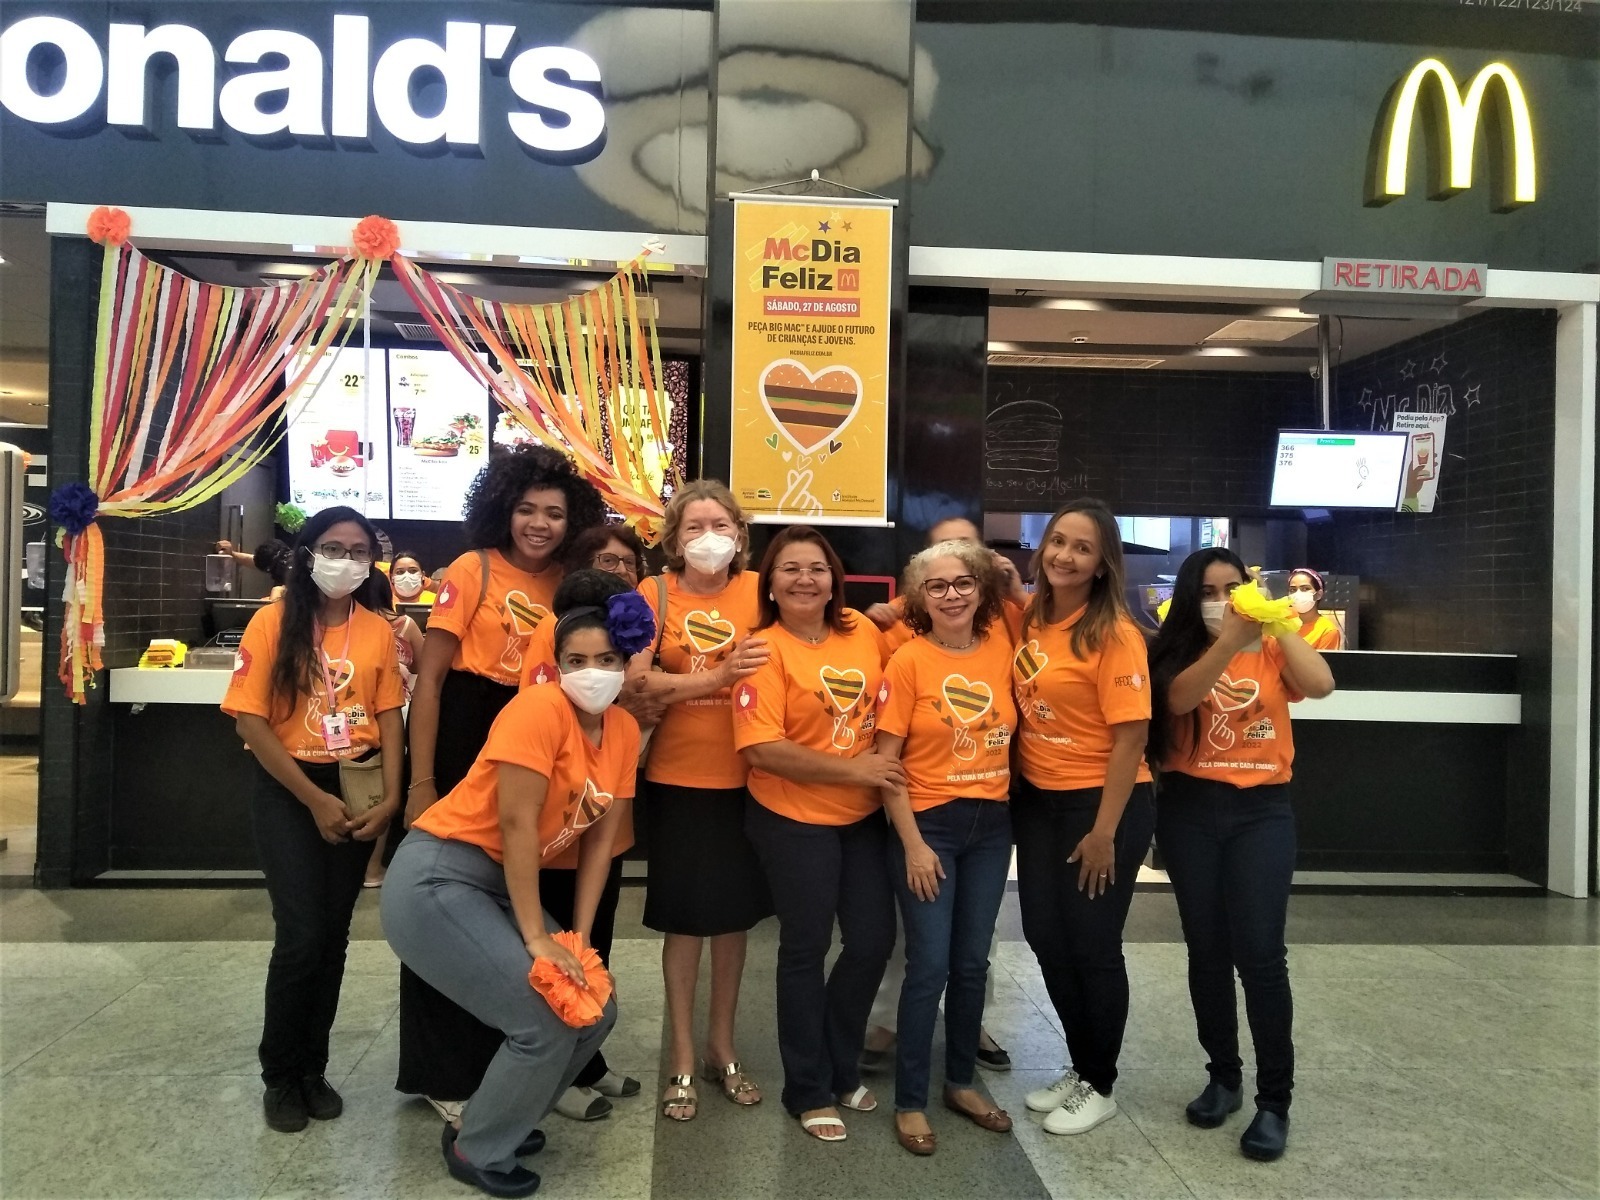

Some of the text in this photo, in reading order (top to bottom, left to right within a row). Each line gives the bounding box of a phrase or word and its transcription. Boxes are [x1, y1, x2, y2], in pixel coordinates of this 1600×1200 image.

[763, 237, 861, 263] McDia
[762, 265, 833, 290] Feliz
[1334, 261, 1482, 292] RETIRADA
[766, 299, 857, 313] SÁBADO, 27 DE AGOSTO
[748, 321, 768, 334] PEÇA
[769, 322, 782, 331] BIG
[806, 324, 811, 333] E
[812, 324, 836, 334] AJUDE
[838, 325, 844, 334] O
[845, 325, 875, 335] FUTURO
[767, 333, 856, 346] DE CRIANÇAS E JOVENS.
[344, 374, 359, 387] 22
[469, 445, 479, 454] 25
